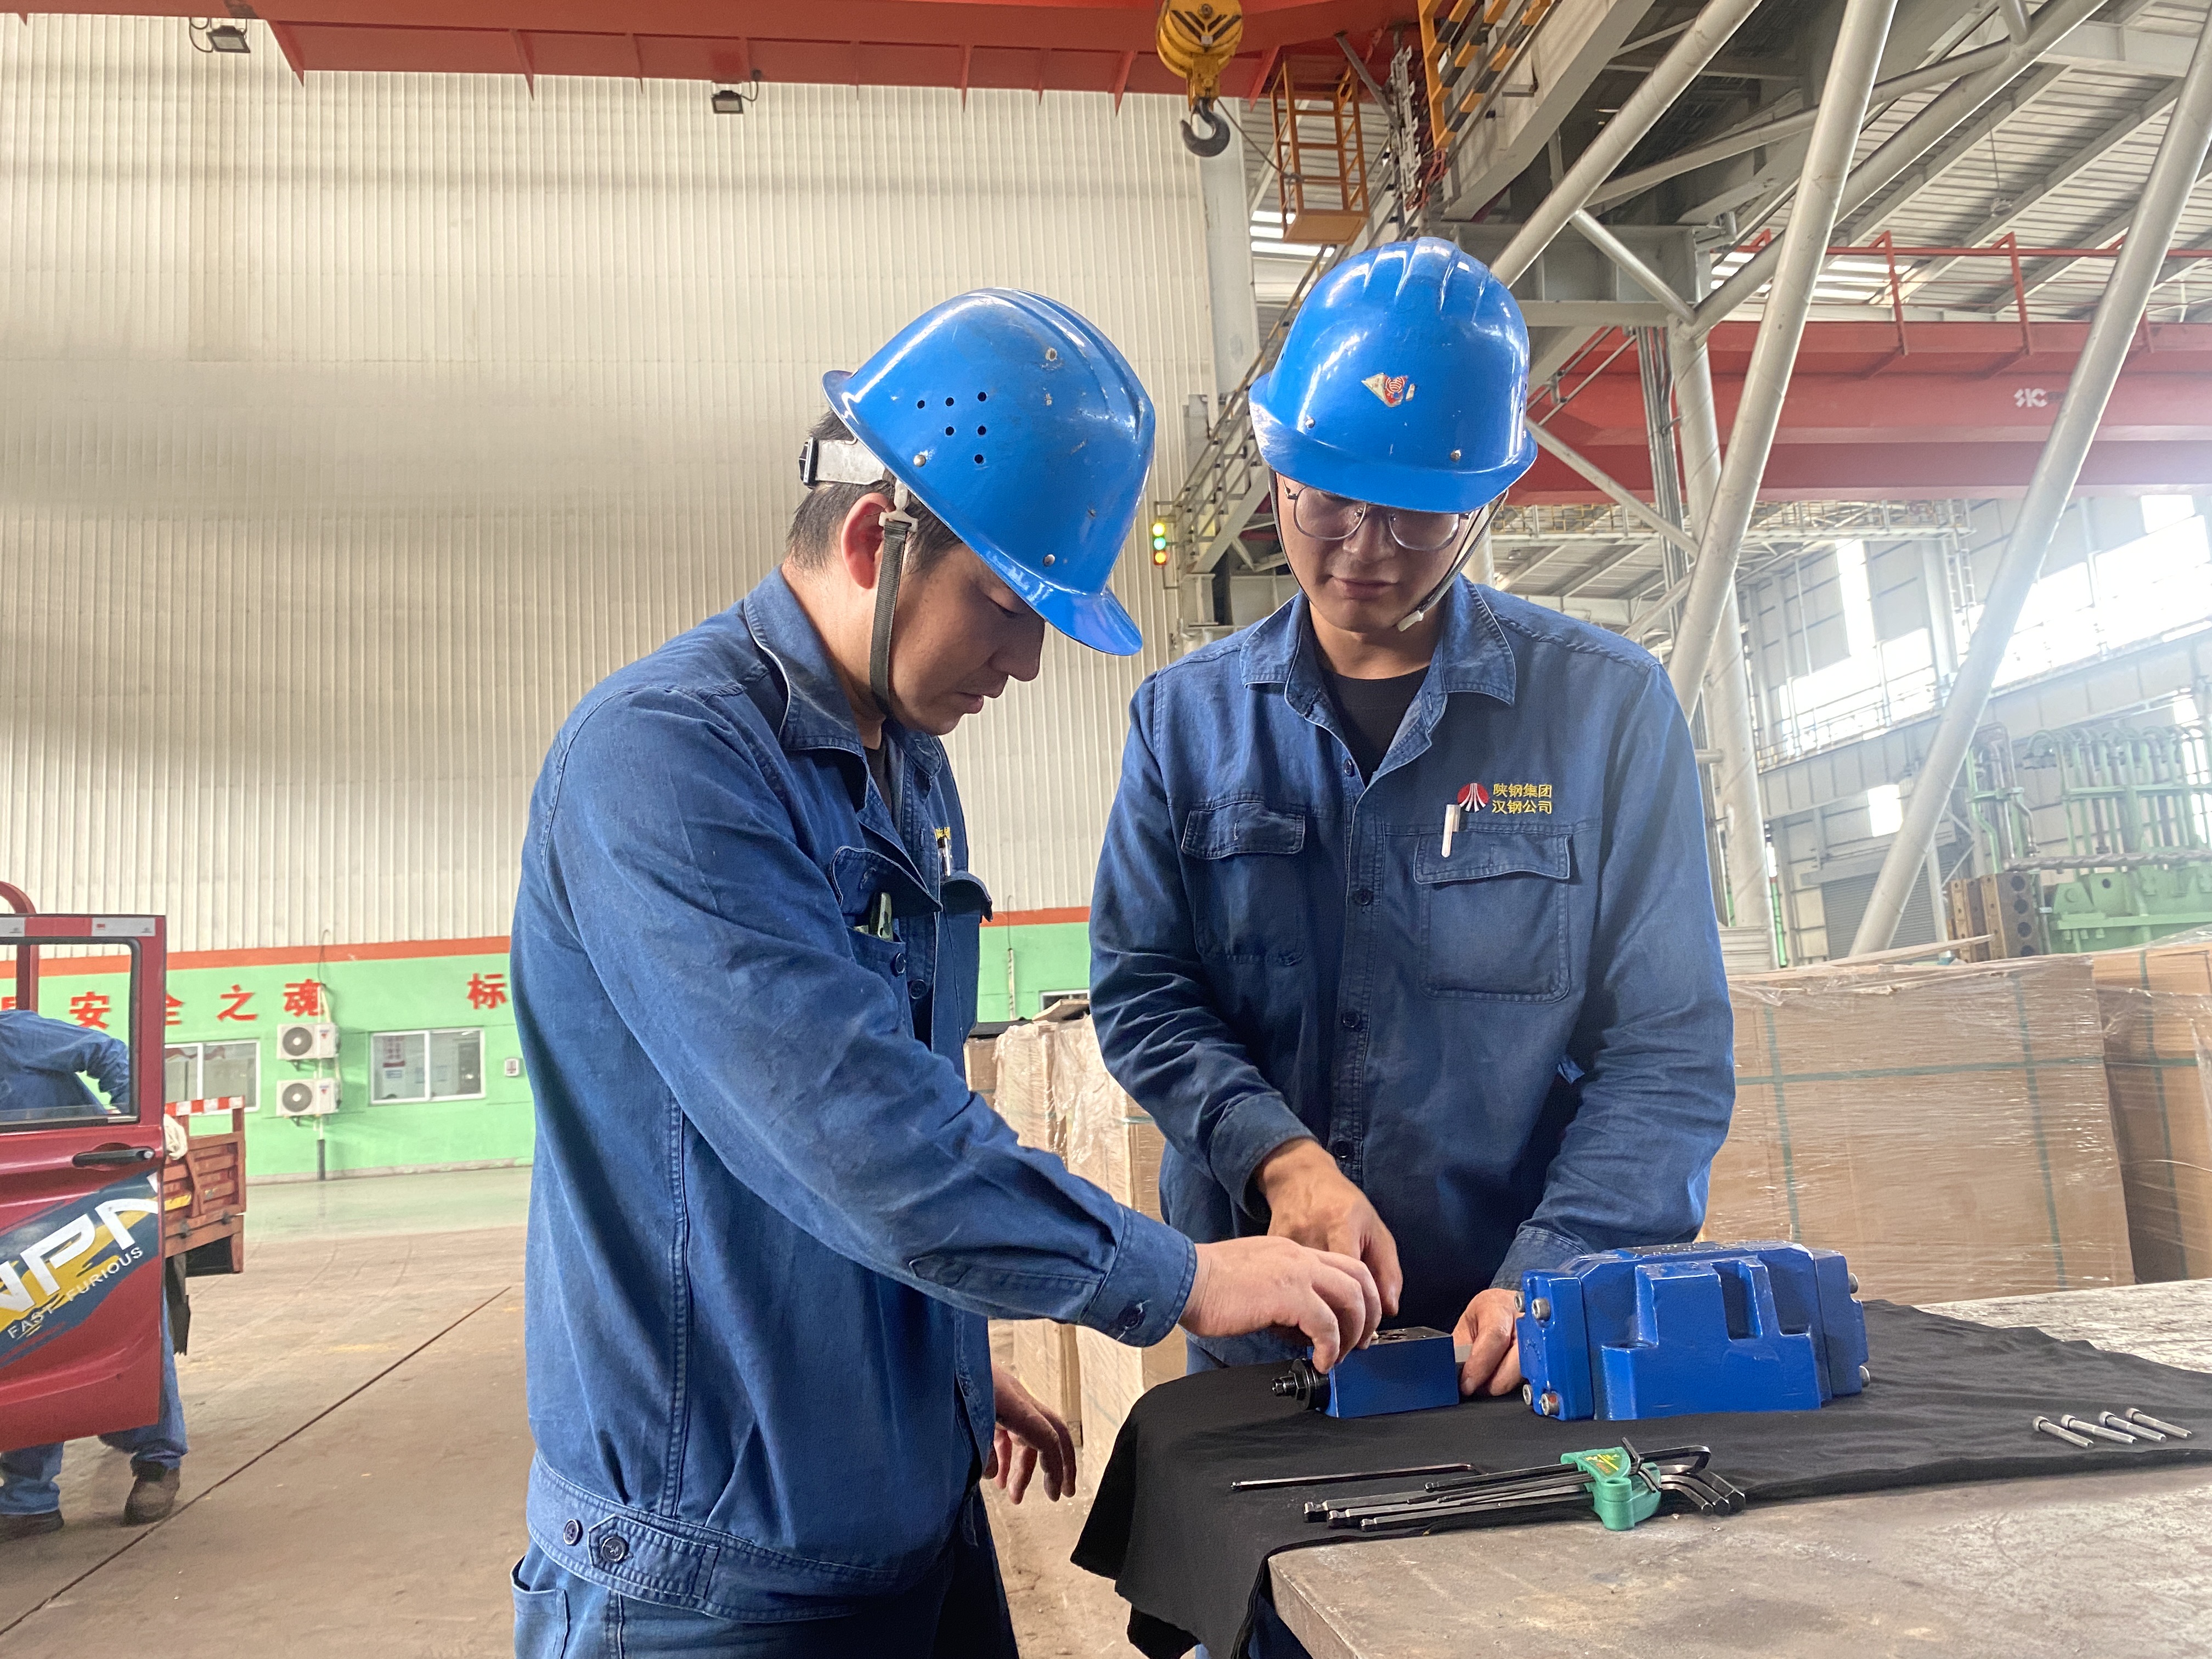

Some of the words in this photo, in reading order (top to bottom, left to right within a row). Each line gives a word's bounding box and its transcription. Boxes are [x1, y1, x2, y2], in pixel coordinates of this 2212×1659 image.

[1493, 783, 1553, 798] 陕钢集团
[1492, 799, 1552, 815] 汉钢公司
[466, 973, 508, 1010] 标
[7, 1301, 57, 1339] FAST
[66, 1246, 143, 1302] FURIOUS
